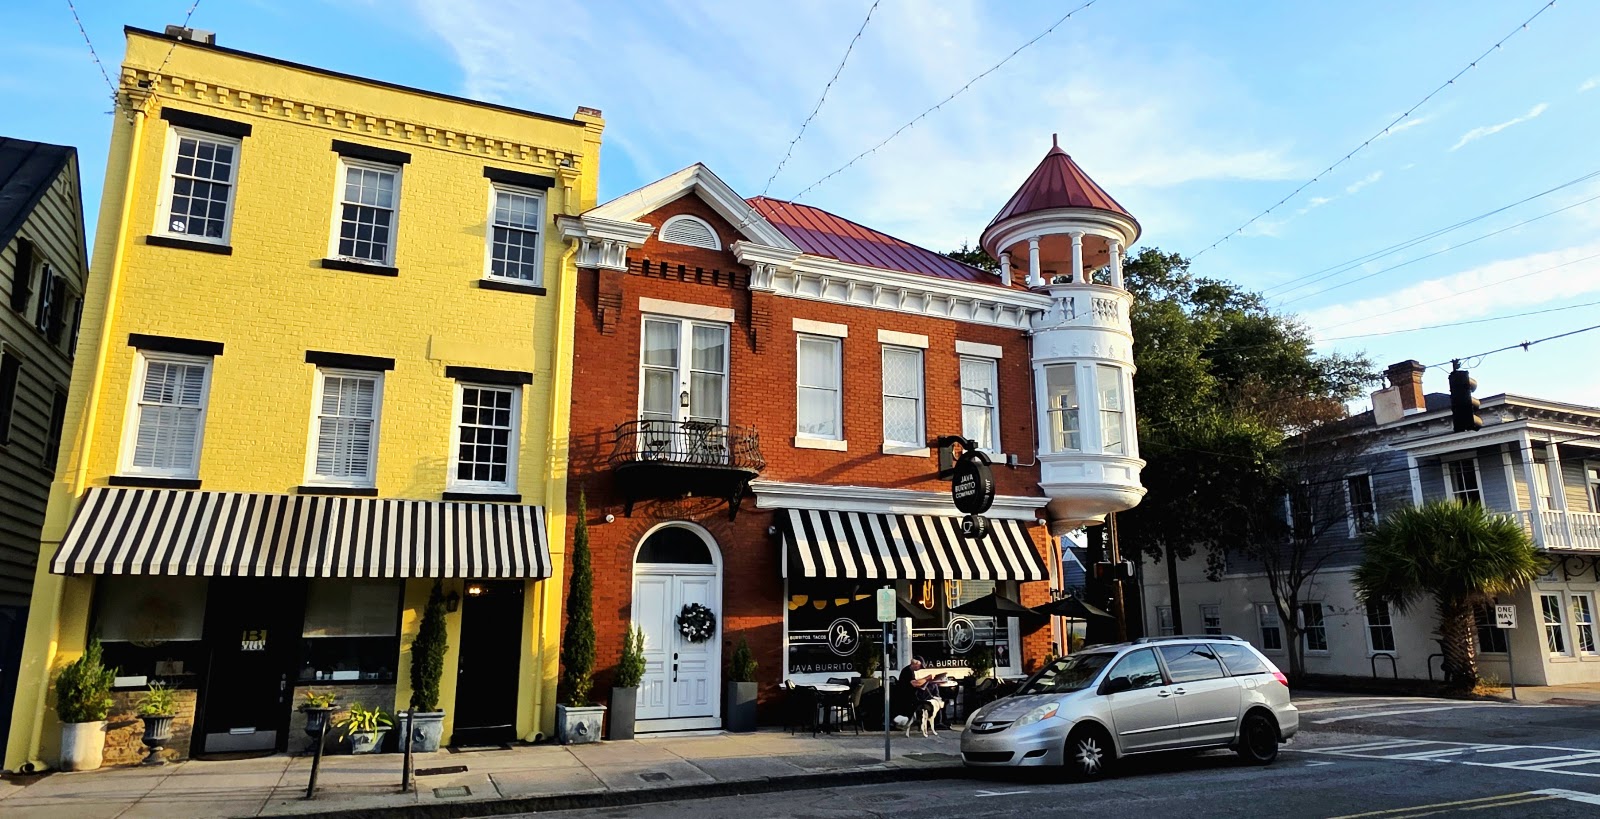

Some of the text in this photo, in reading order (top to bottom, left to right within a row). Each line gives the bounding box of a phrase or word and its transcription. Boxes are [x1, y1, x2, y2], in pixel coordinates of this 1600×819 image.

[961, 474, 973, 483] JAVA
[955, 481, 976, 493] BURRITO
[955, 489, 976, 499] COMPANY
[790, 662, 853, 672] JAVA BURRITO
